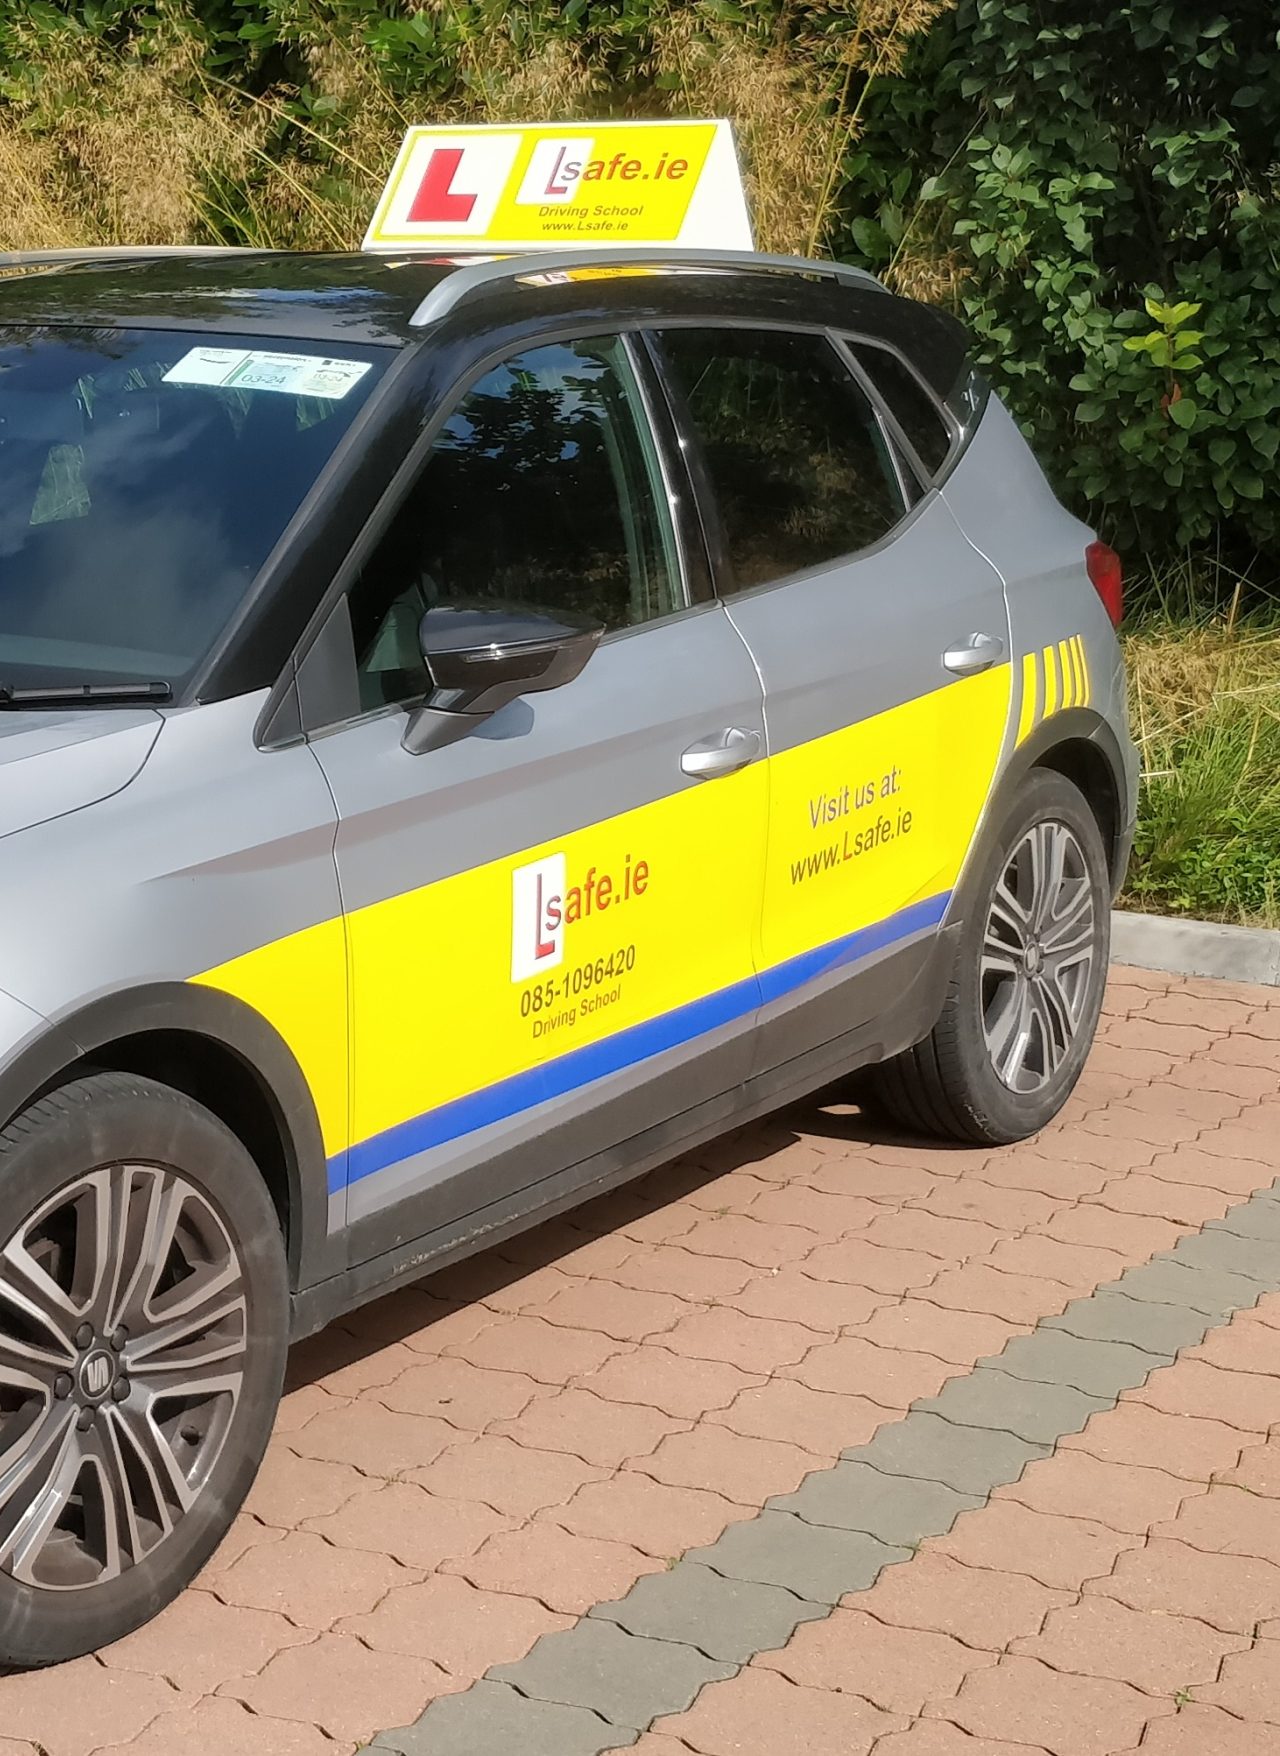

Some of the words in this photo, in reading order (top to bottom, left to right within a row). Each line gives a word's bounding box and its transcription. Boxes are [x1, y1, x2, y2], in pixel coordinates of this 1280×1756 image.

[406, 148, 478, 222] L
[544, 146, 688, 195] Lsafe.ie
[538, 206, 589, 218] Driving
[593, 205, 644, 216] School
[542, 220, 629, 231] www.Lsafe.ie
[241, 373, 286, 385] 03-24
[810, 785, 849, 829] Visit
[855, 781, 875, 809] us
[880, 764, 902, 798] at:
[790, 807, 912, 885] www.Lsafe.ie
[534, 854, 649, 960] Lsafe.ie
[520, 944, 635, 1017] 085-1096420
[532, 1007, 576, 1038] Driving
[580, 984, 621, 1017] School
